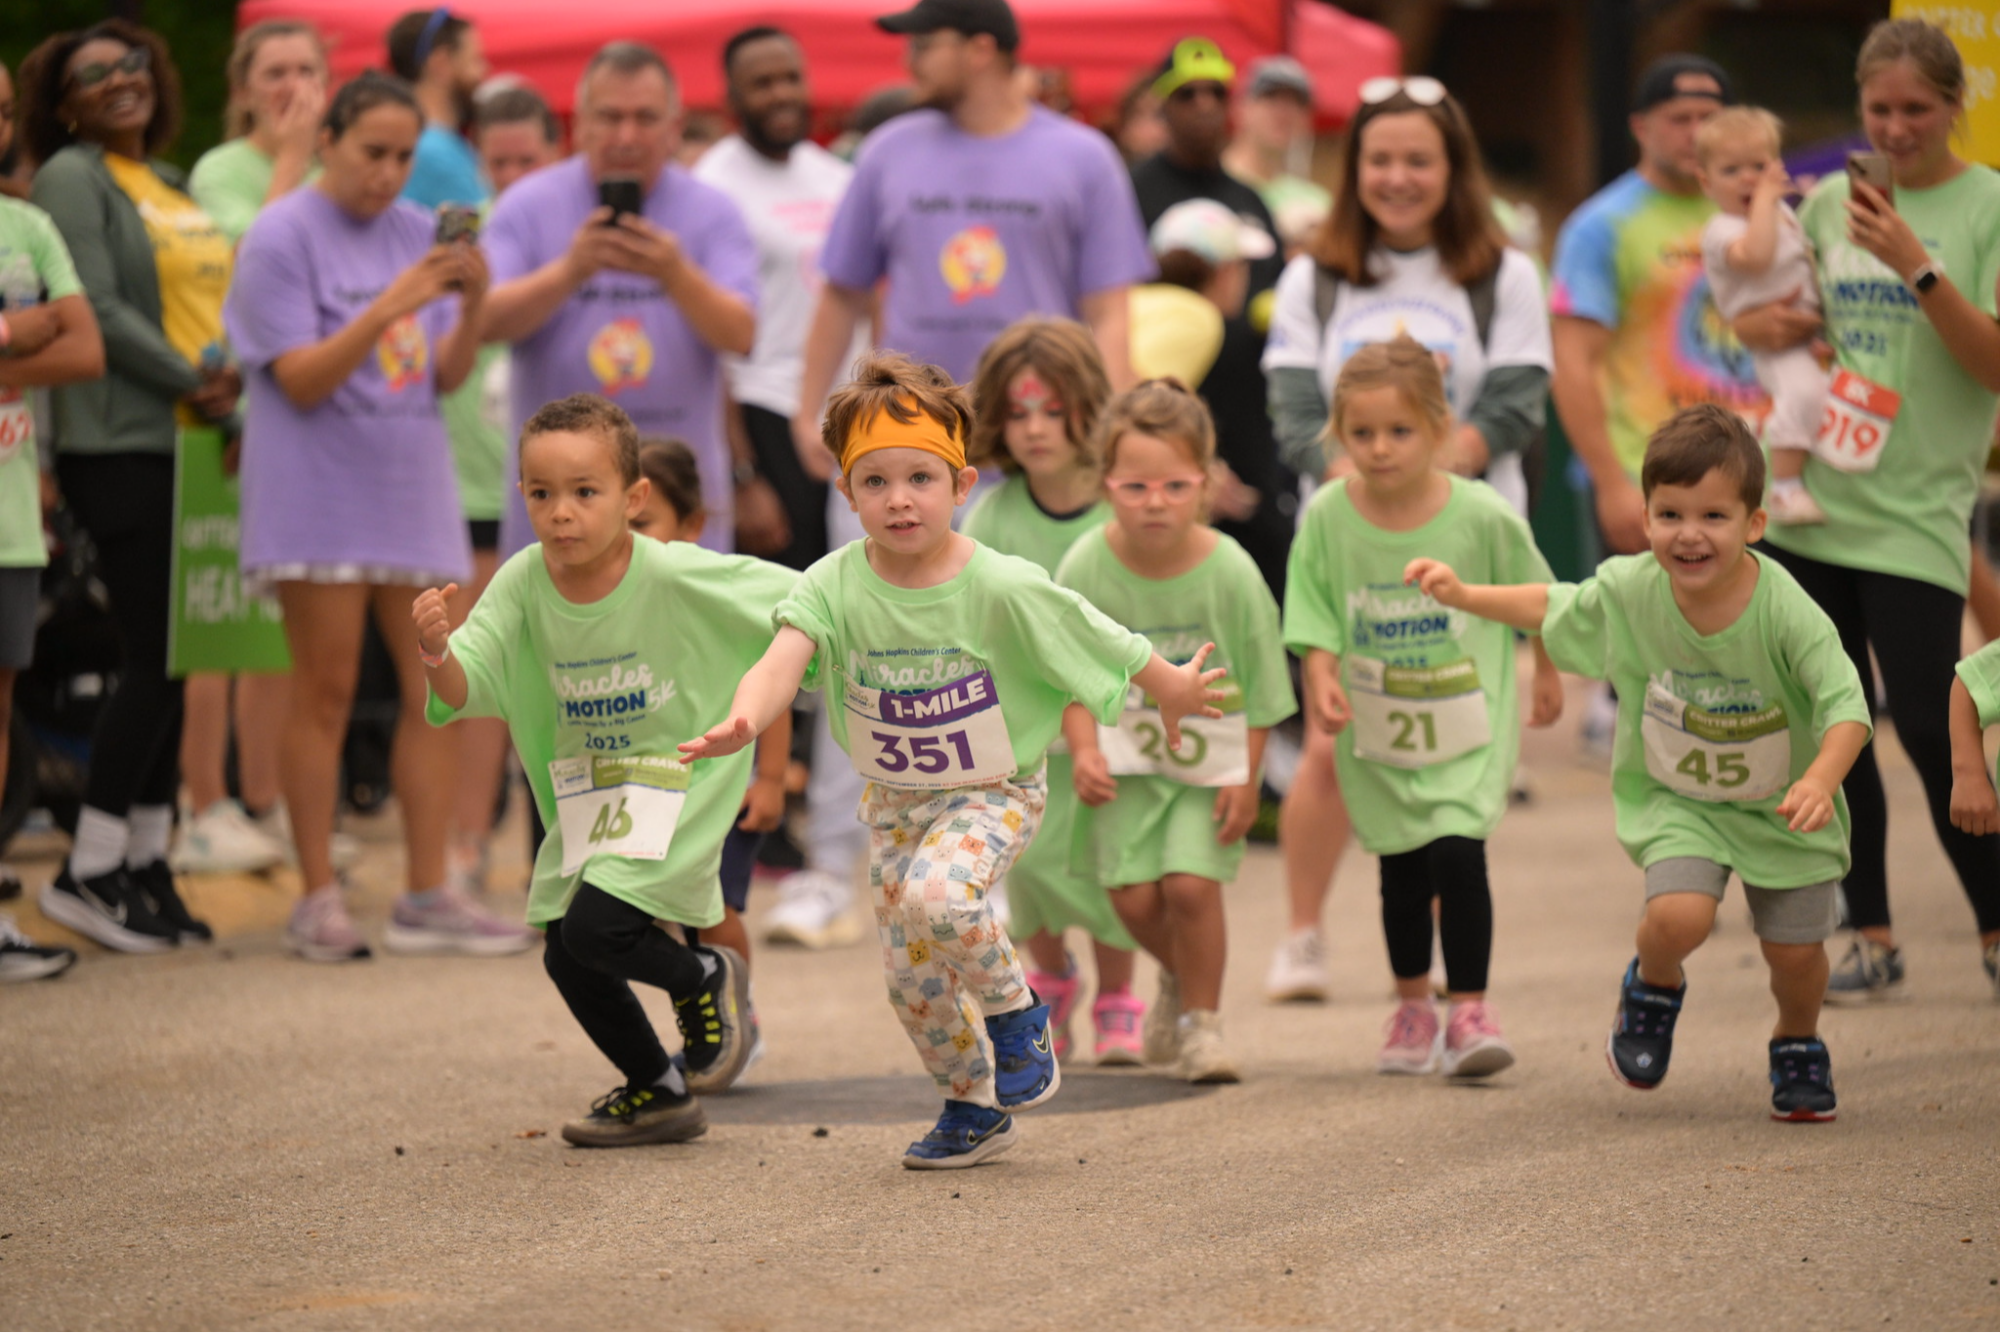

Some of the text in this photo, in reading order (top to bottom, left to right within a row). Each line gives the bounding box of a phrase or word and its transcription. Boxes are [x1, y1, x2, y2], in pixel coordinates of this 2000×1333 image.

[867, 646, 961, 658] Johns Hopkins Children's Center
[566, 690, 646, 718] MOTION
[891, 676, 988, 720] 1-MILE
[584, 733, 631, 750] 2025
[871, 729, 976, 774] 351
[1134, 721, 1208, 767] 20
[1387, 710, 1438, 752] 21
[1676, 748, 1751, 788] 45
[588, 796, 633, 846] 46
